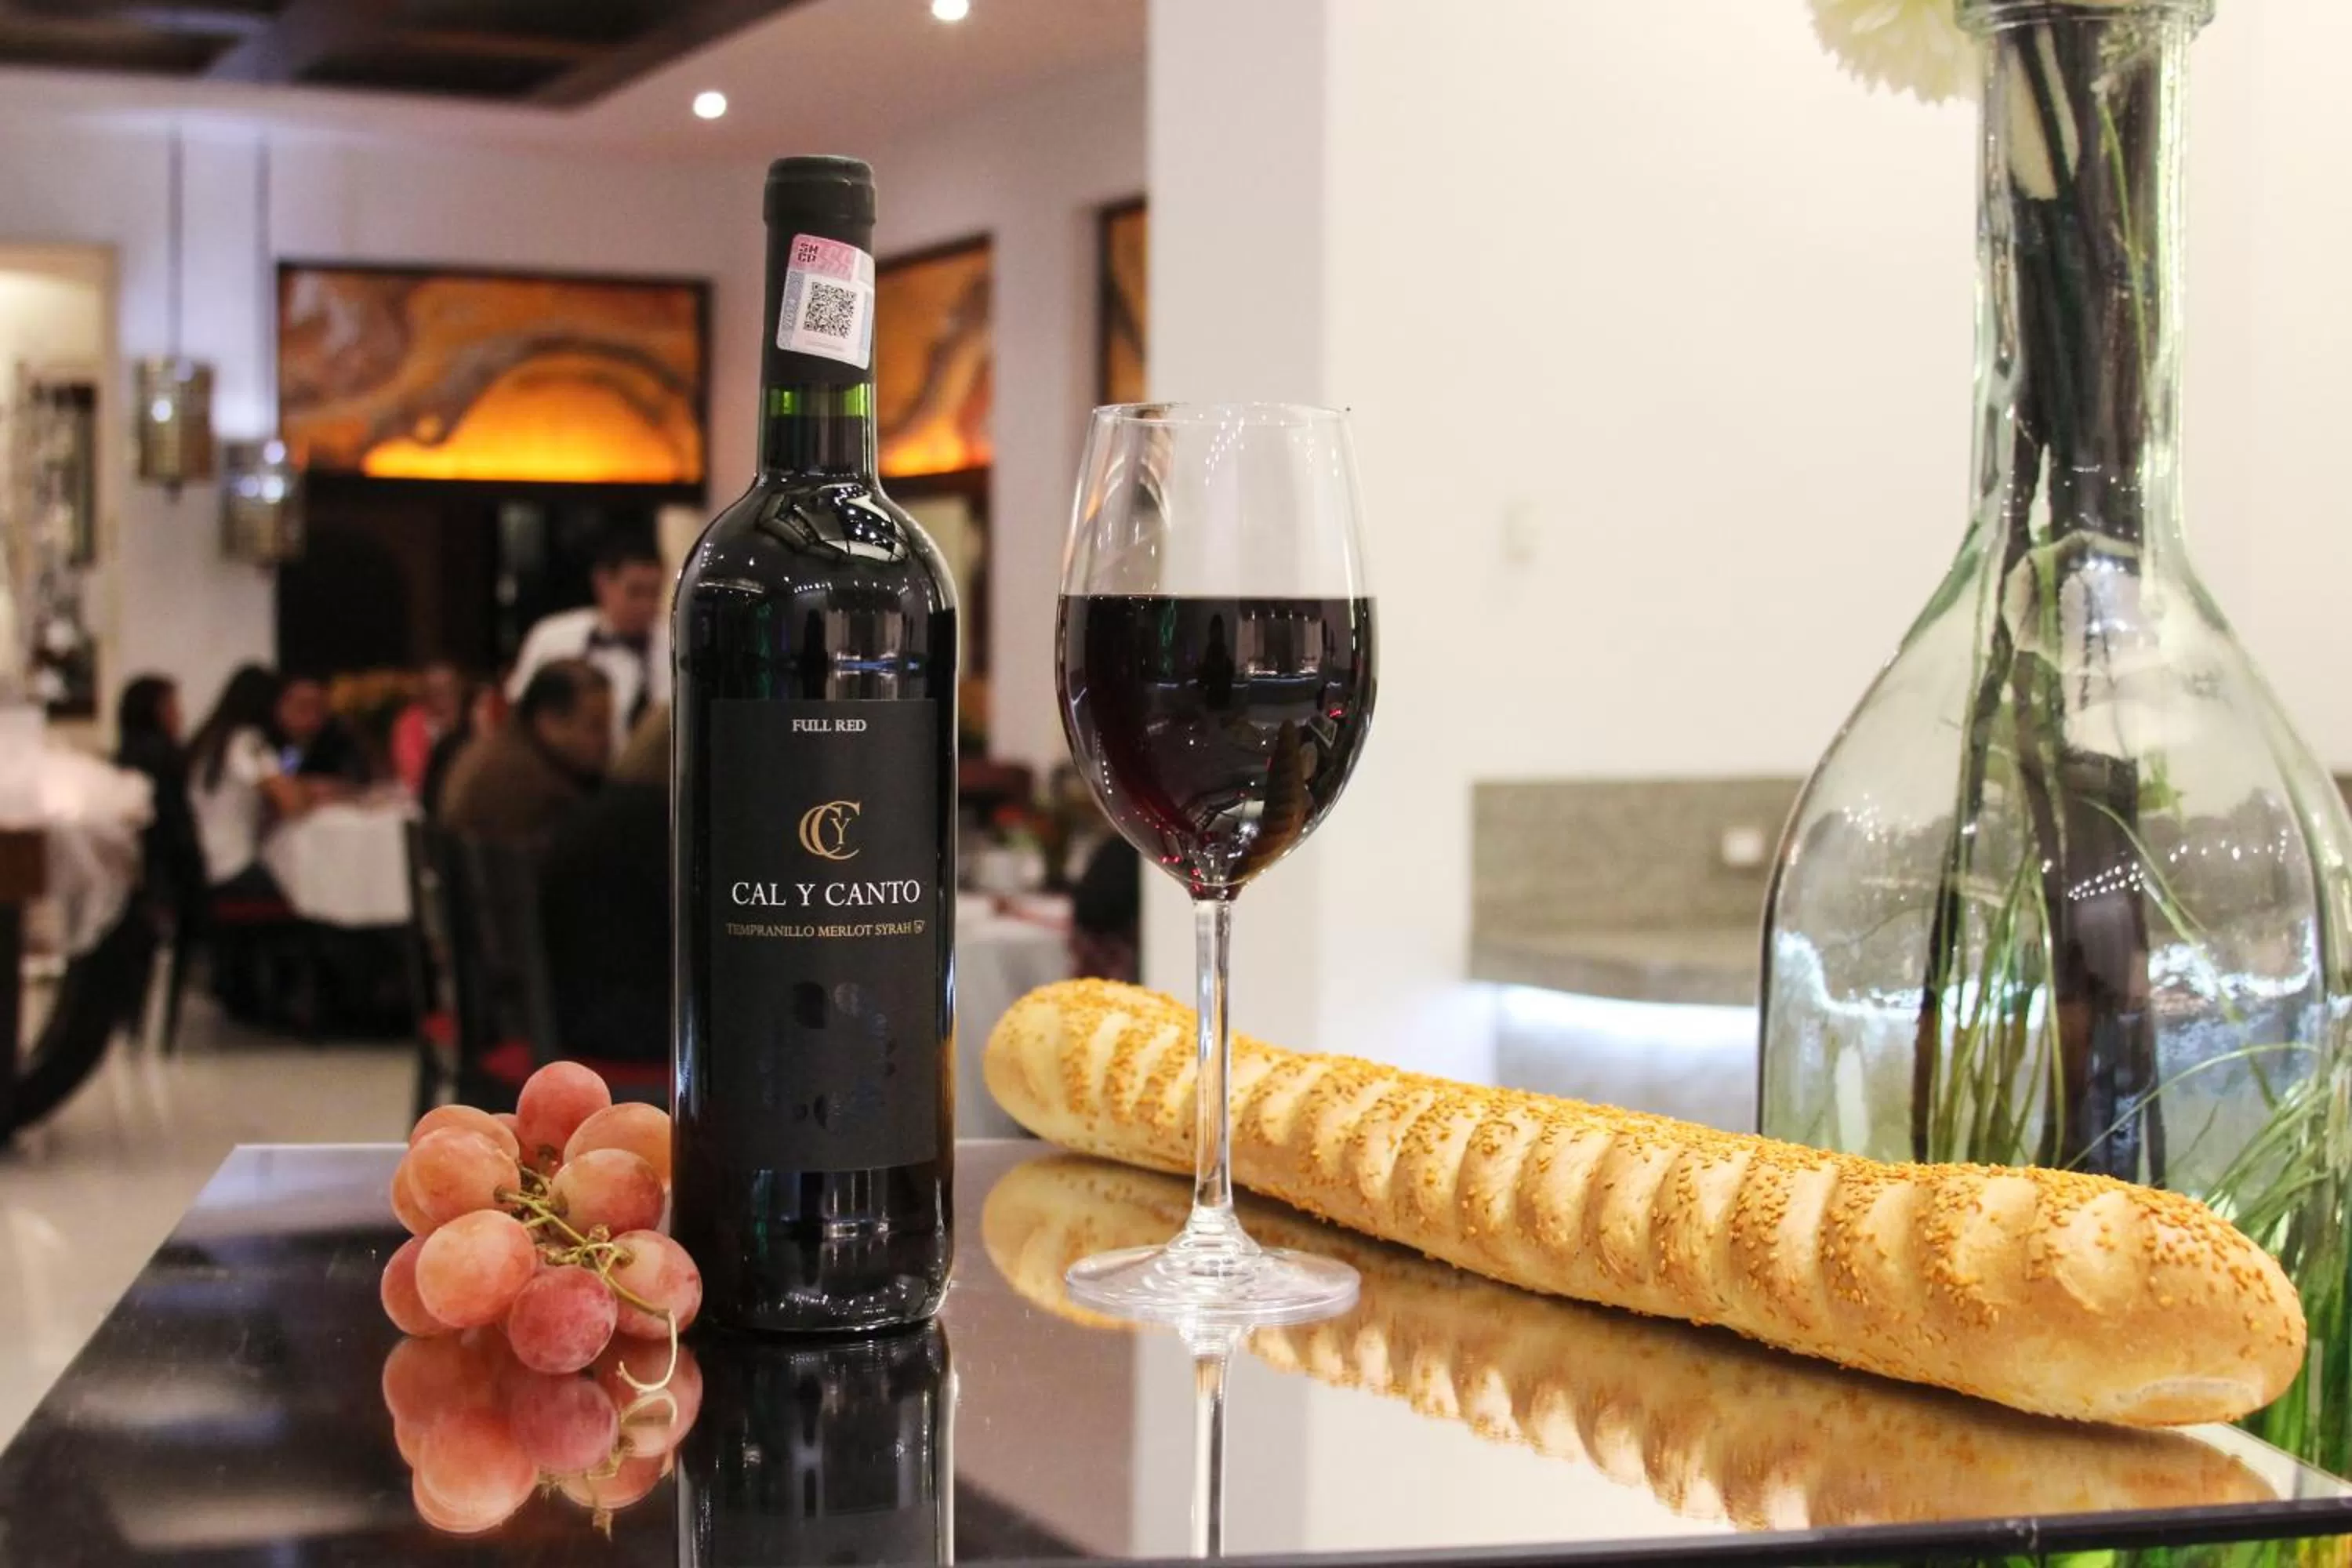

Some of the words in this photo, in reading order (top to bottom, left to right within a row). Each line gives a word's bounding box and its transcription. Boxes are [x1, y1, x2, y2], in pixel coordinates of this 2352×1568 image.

[799, 242, 818, 254] SH
[792, 719, 831, 731] FULL
[835, 719, 867, 731] RED
[731, 882, 786, 906] CAL
[796, 883, 816, 906] Y
[825, 880, 920, 906] CANTO
[726, 922, 815, 937] TEMPRANILLO
[818, 924, 873, 937] MERLOT
[874, 920, 912, 935] SYRAH
